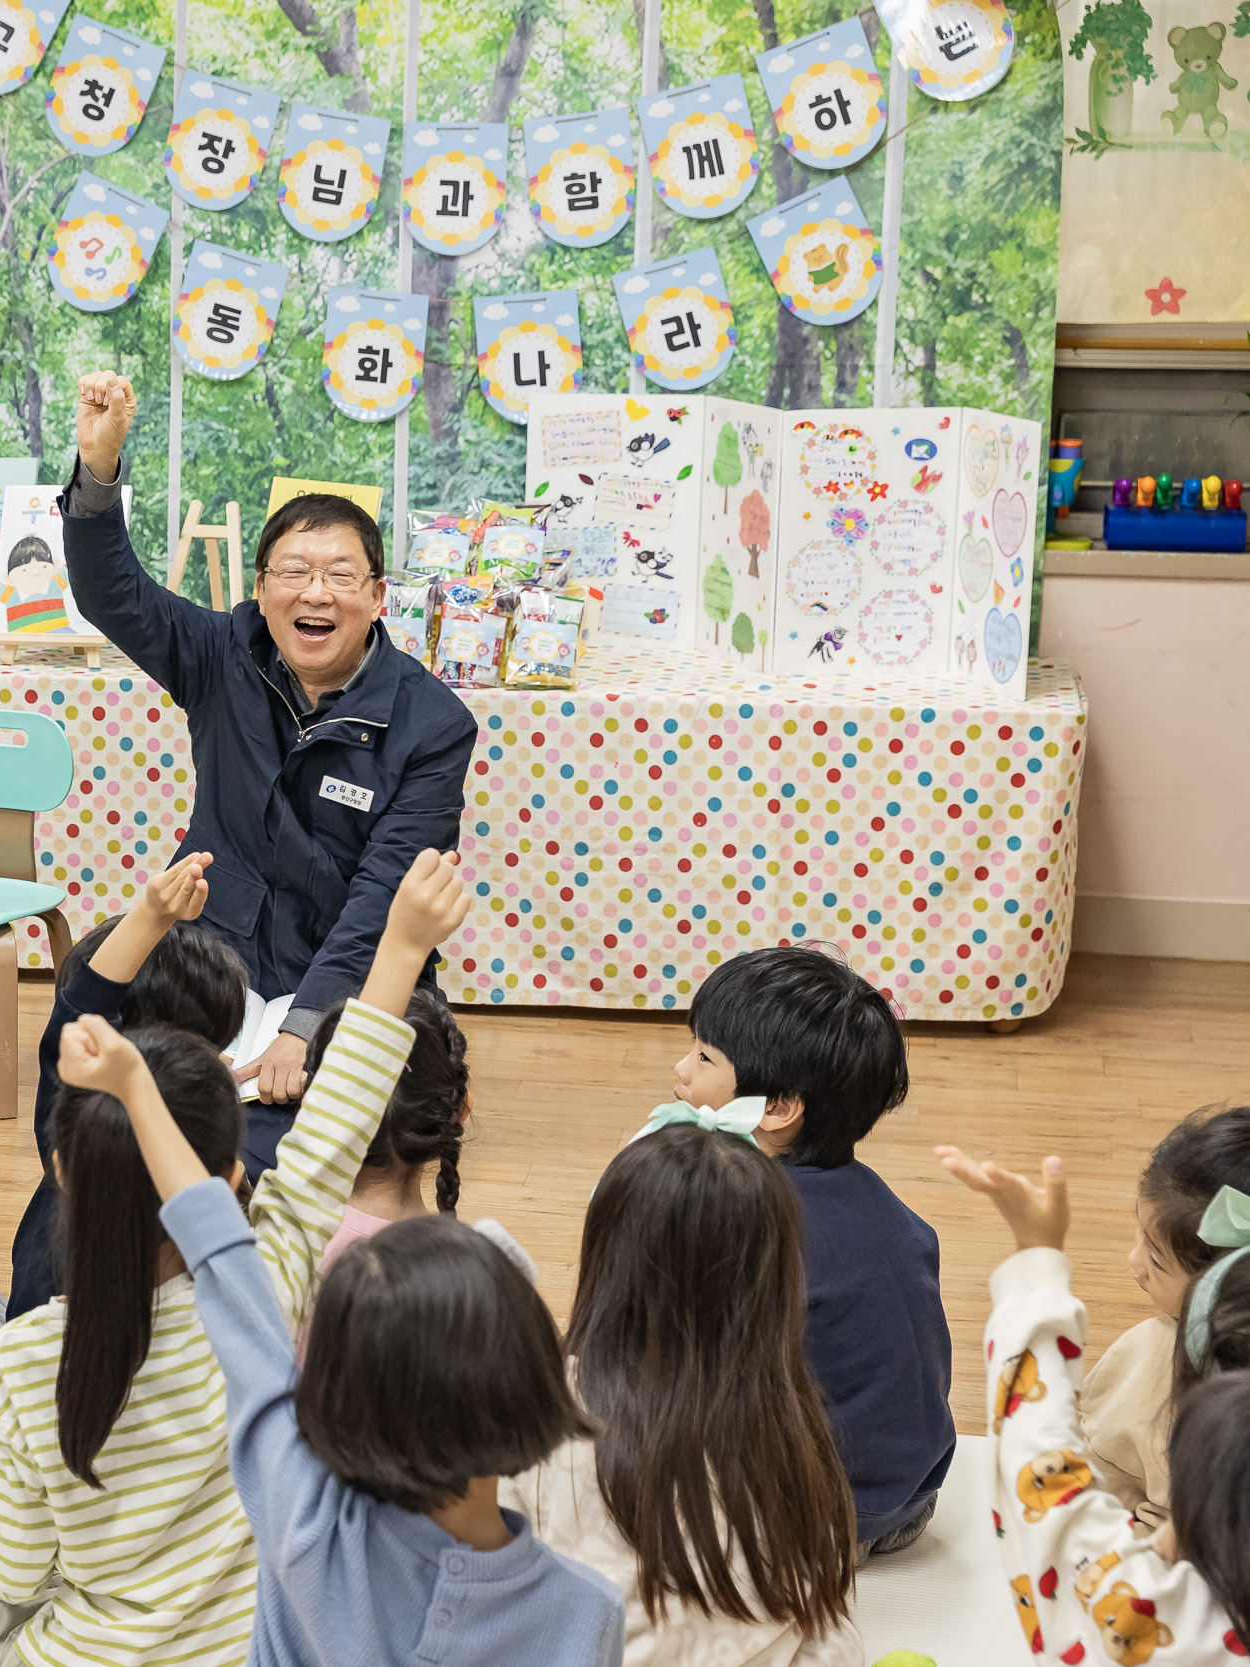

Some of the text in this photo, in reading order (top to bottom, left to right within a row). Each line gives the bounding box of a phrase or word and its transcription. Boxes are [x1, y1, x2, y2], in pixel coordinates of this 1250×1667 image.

[79, 79, 116, 122] 청
[197, 131, 236, 175] 장
[312, 164, 347, 206] 님
[436, 179, 474, 217] 과
[563, 171, 602, 212] 함
[681, 138, 725, 180] 께
[808, 88, 852, 131] 하
[206, 302, 702, 387] 동 화 나 라
